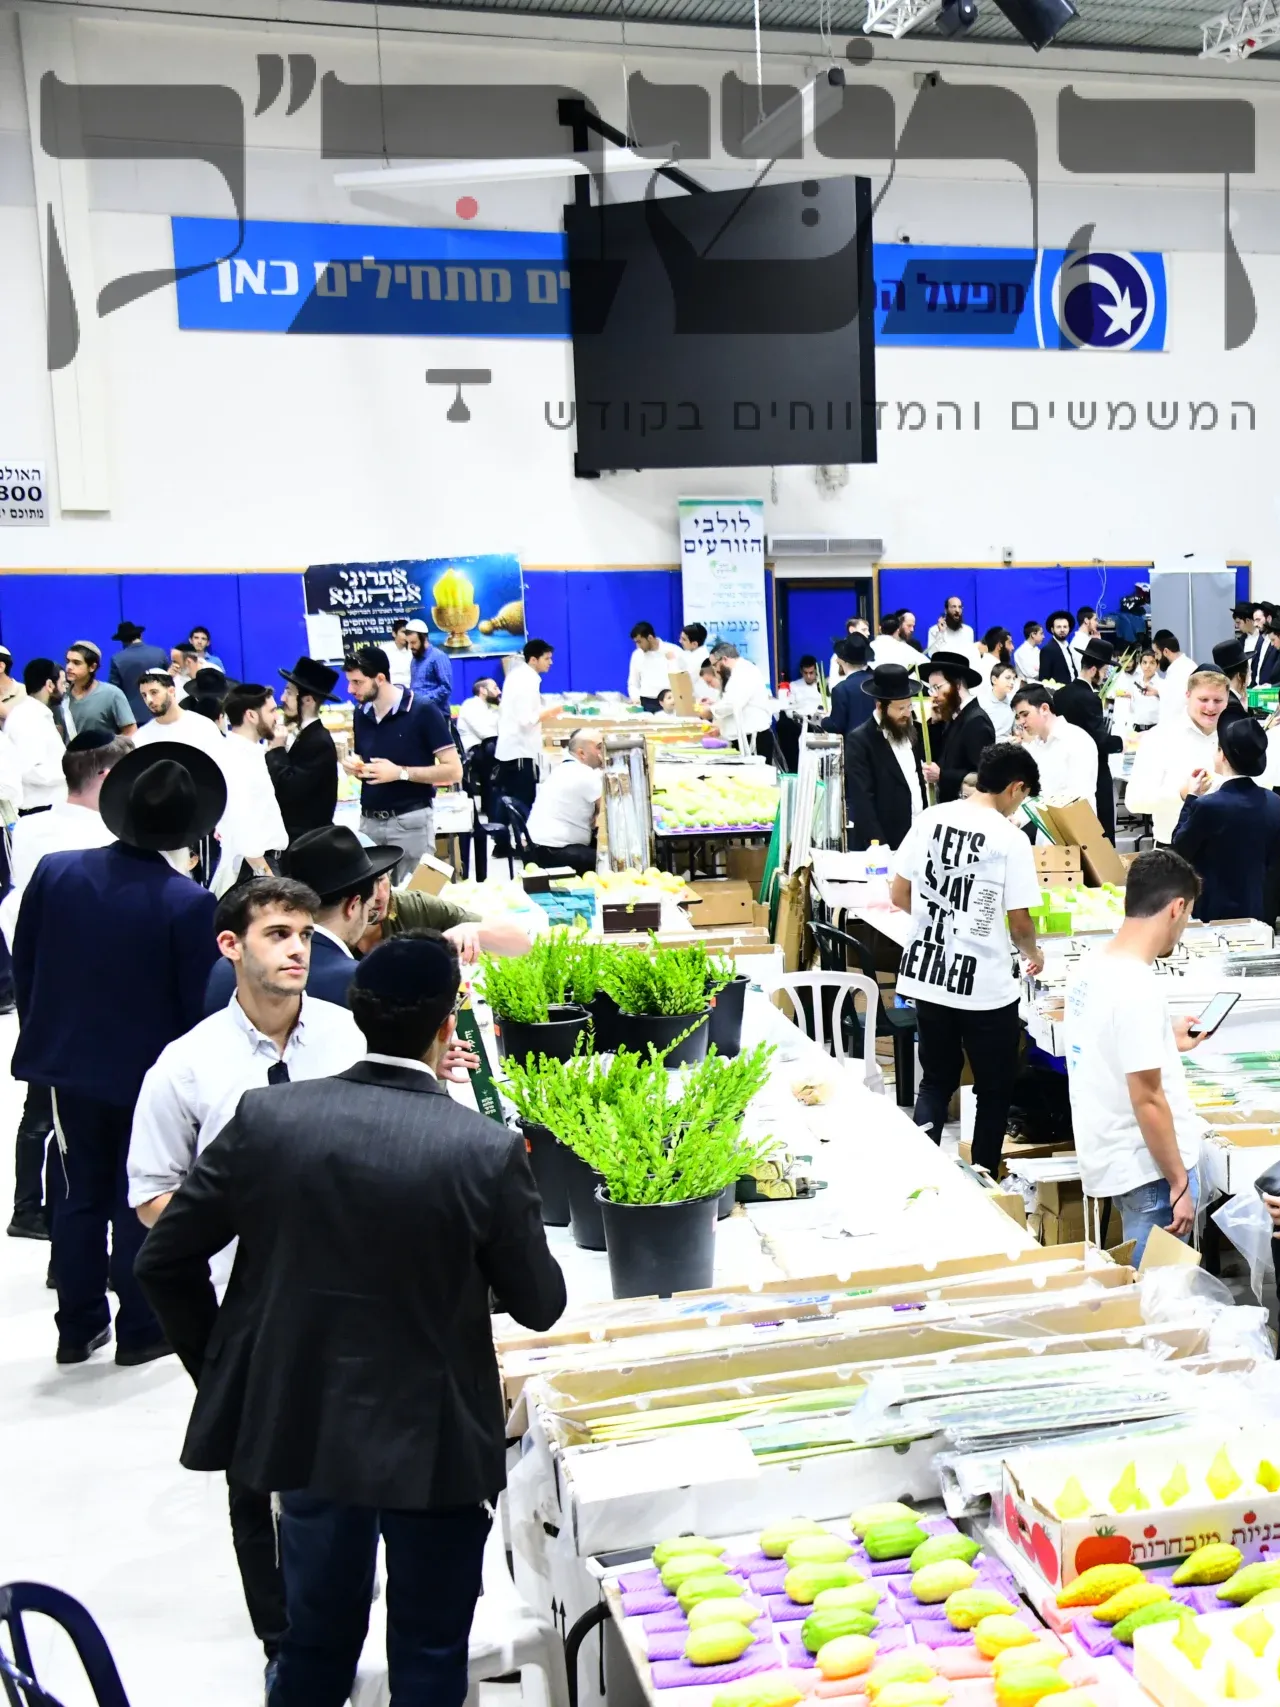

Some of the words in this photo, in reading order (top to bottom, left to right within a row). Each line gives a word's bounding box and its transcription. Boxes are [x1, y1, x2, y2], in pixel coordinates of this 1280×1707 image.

[216, 258, 299, 302] כאן
[314, 255, 512, 303] מתחילים
[917, 273, 1025, 314] מפעל
[10, 508, 44, 519] מתוכם
[694, 511, 750, 533] לולבי
[684, 538, 761, 556] הזורעים
[693, 620, 760, 633] מצמיחי
[1130, 1531, 1221, 1561] מובחרות
